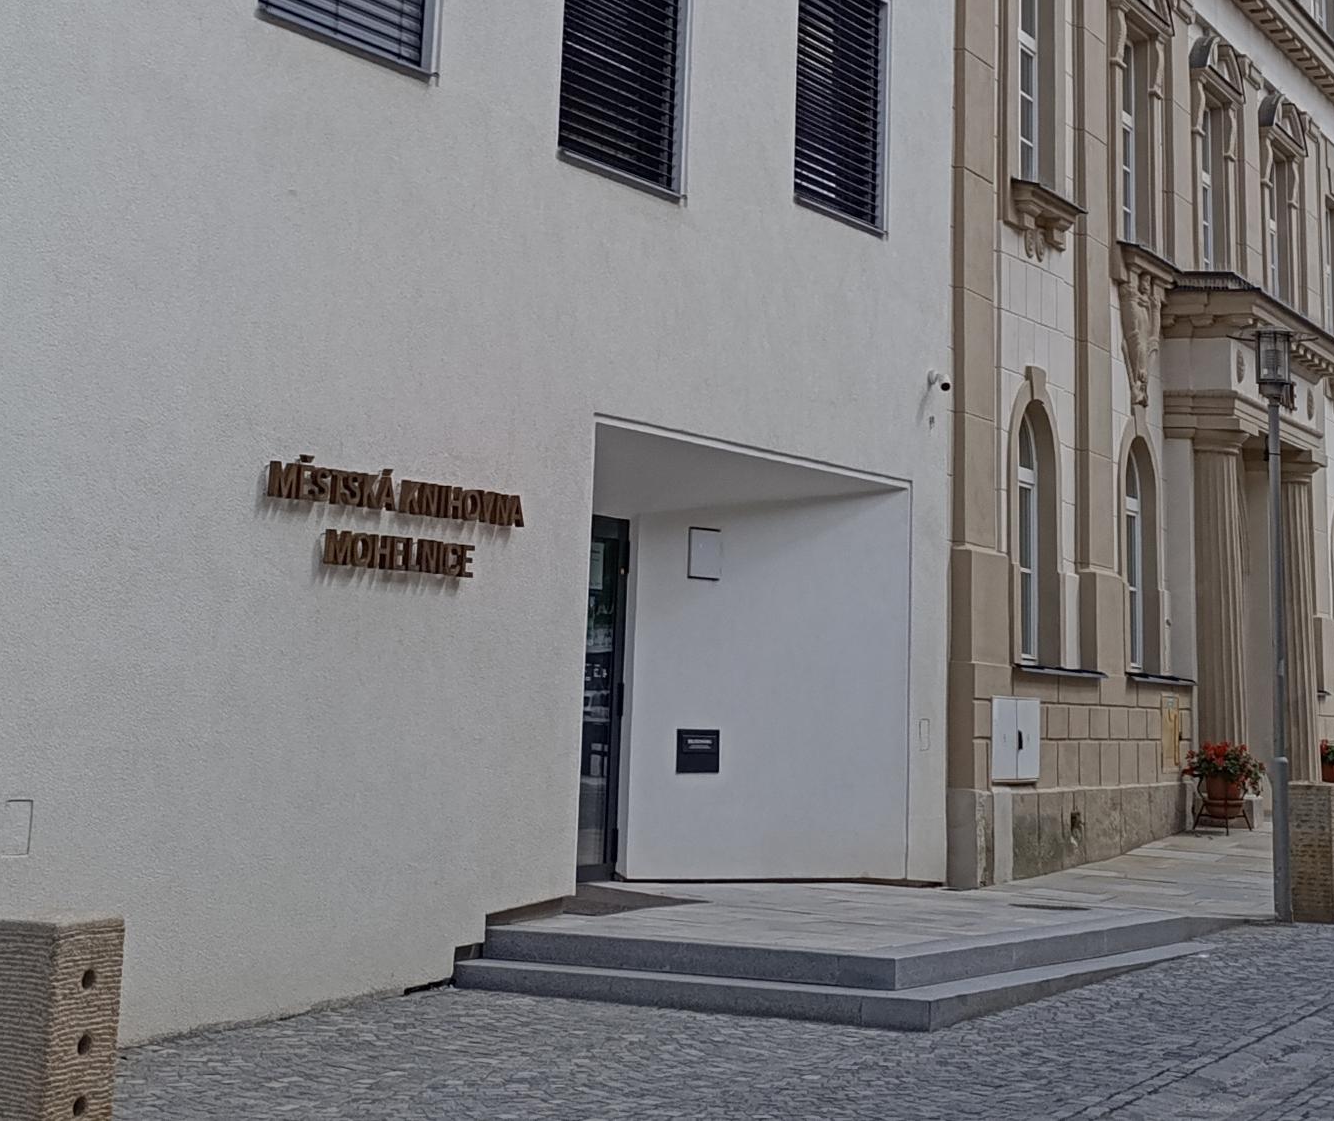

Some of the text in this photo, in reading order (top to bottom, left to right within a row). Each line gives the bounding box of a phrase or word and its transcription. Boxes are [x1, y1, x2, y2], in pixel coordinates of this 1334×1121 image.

[267, 454, 525, 527] MĚSTSKÁ KNIHOVNA
[323, 529, 475, 578] MOHELNICE
